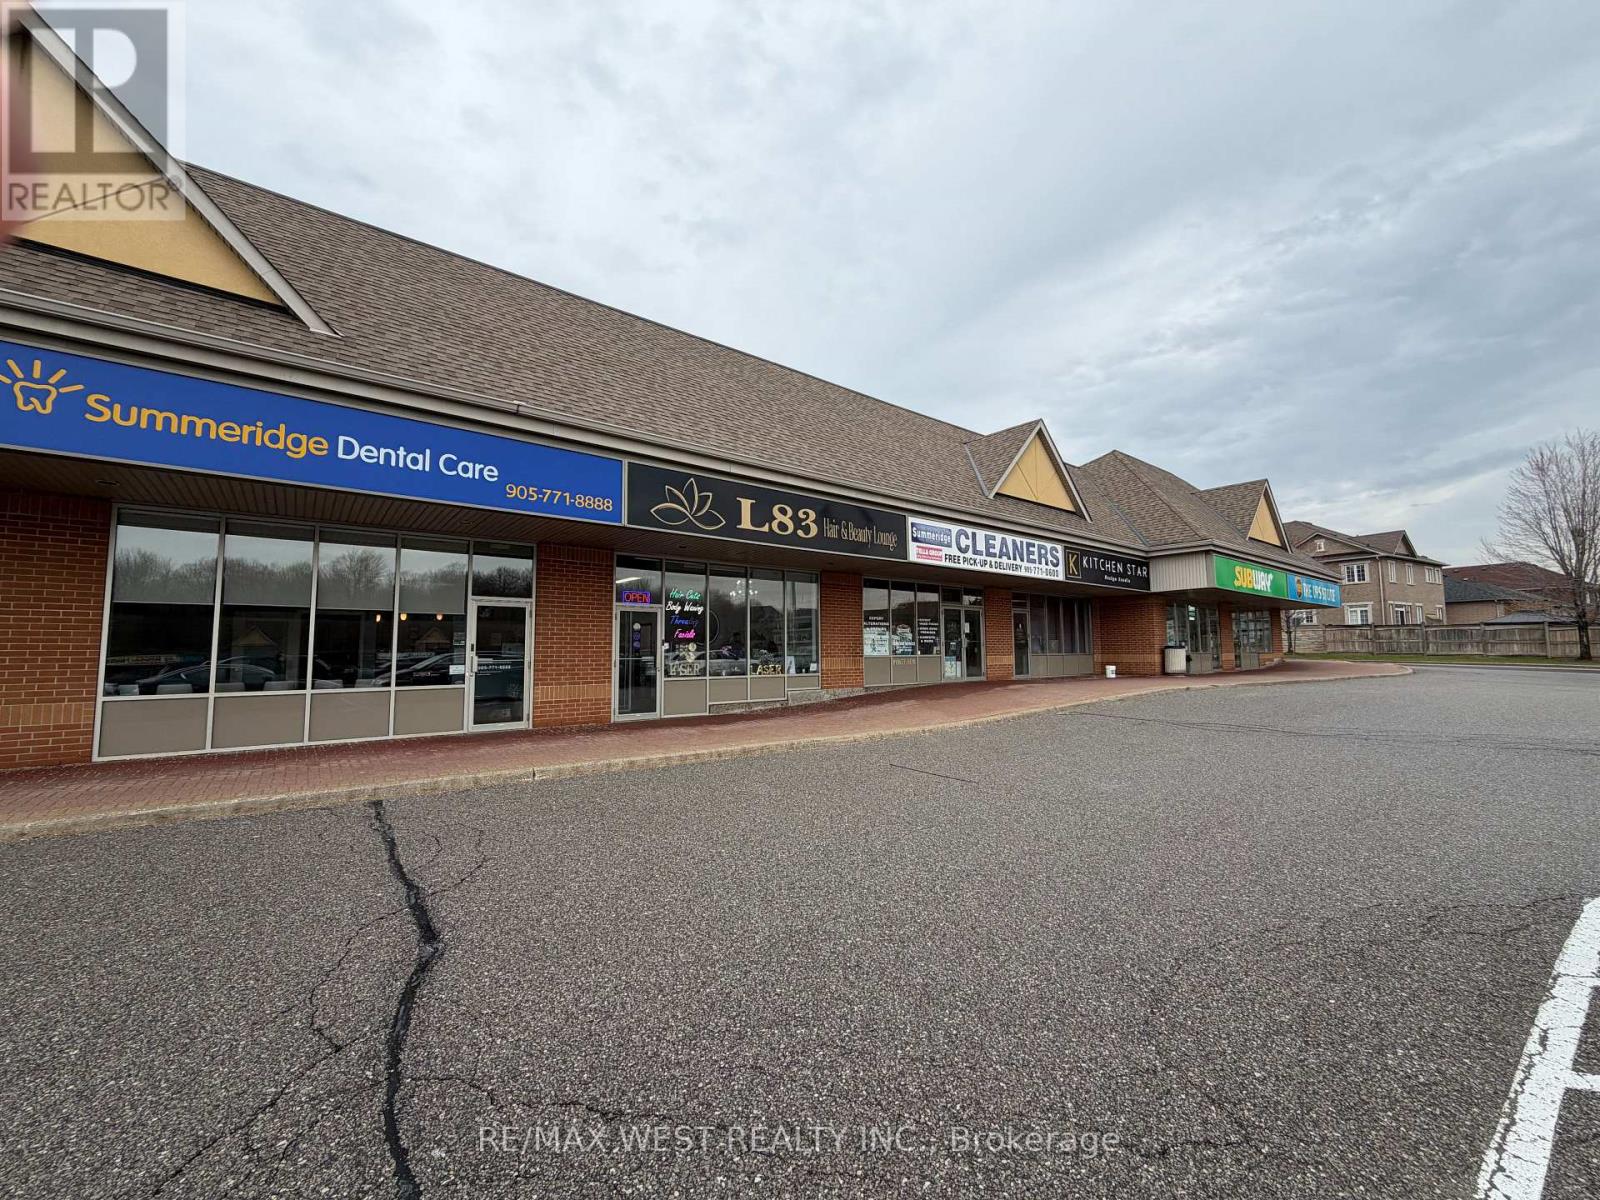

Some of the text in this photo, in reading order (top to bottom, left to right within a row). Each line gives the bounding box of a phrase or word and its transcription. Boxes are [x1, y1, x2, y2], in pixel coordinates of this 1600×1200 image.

[85, 393, 499, 483] Summeridge Dental Care
[505, 482, 613, 512] 905-771-8888
[736, 497, 898, 552] L83 Hair & Beauty Lounge
[912, 526, 1060, 568] Summeridge CLEANERS
[944, 553, 962, 565] FREE
[962, 556, 988, 569] PICK-UP
[988, 560, 994, 569] &
[994, 560, 1023, 573] DELIVERY
[1068, 553, 1078, 575] K
[1082, 556, 1148, 578] KITCHEN STAR
[1234, 566, 1274, 593] SUBWAY
[624, 592, 650, 604] OPEN
[666, 601, 682, 615] Body
